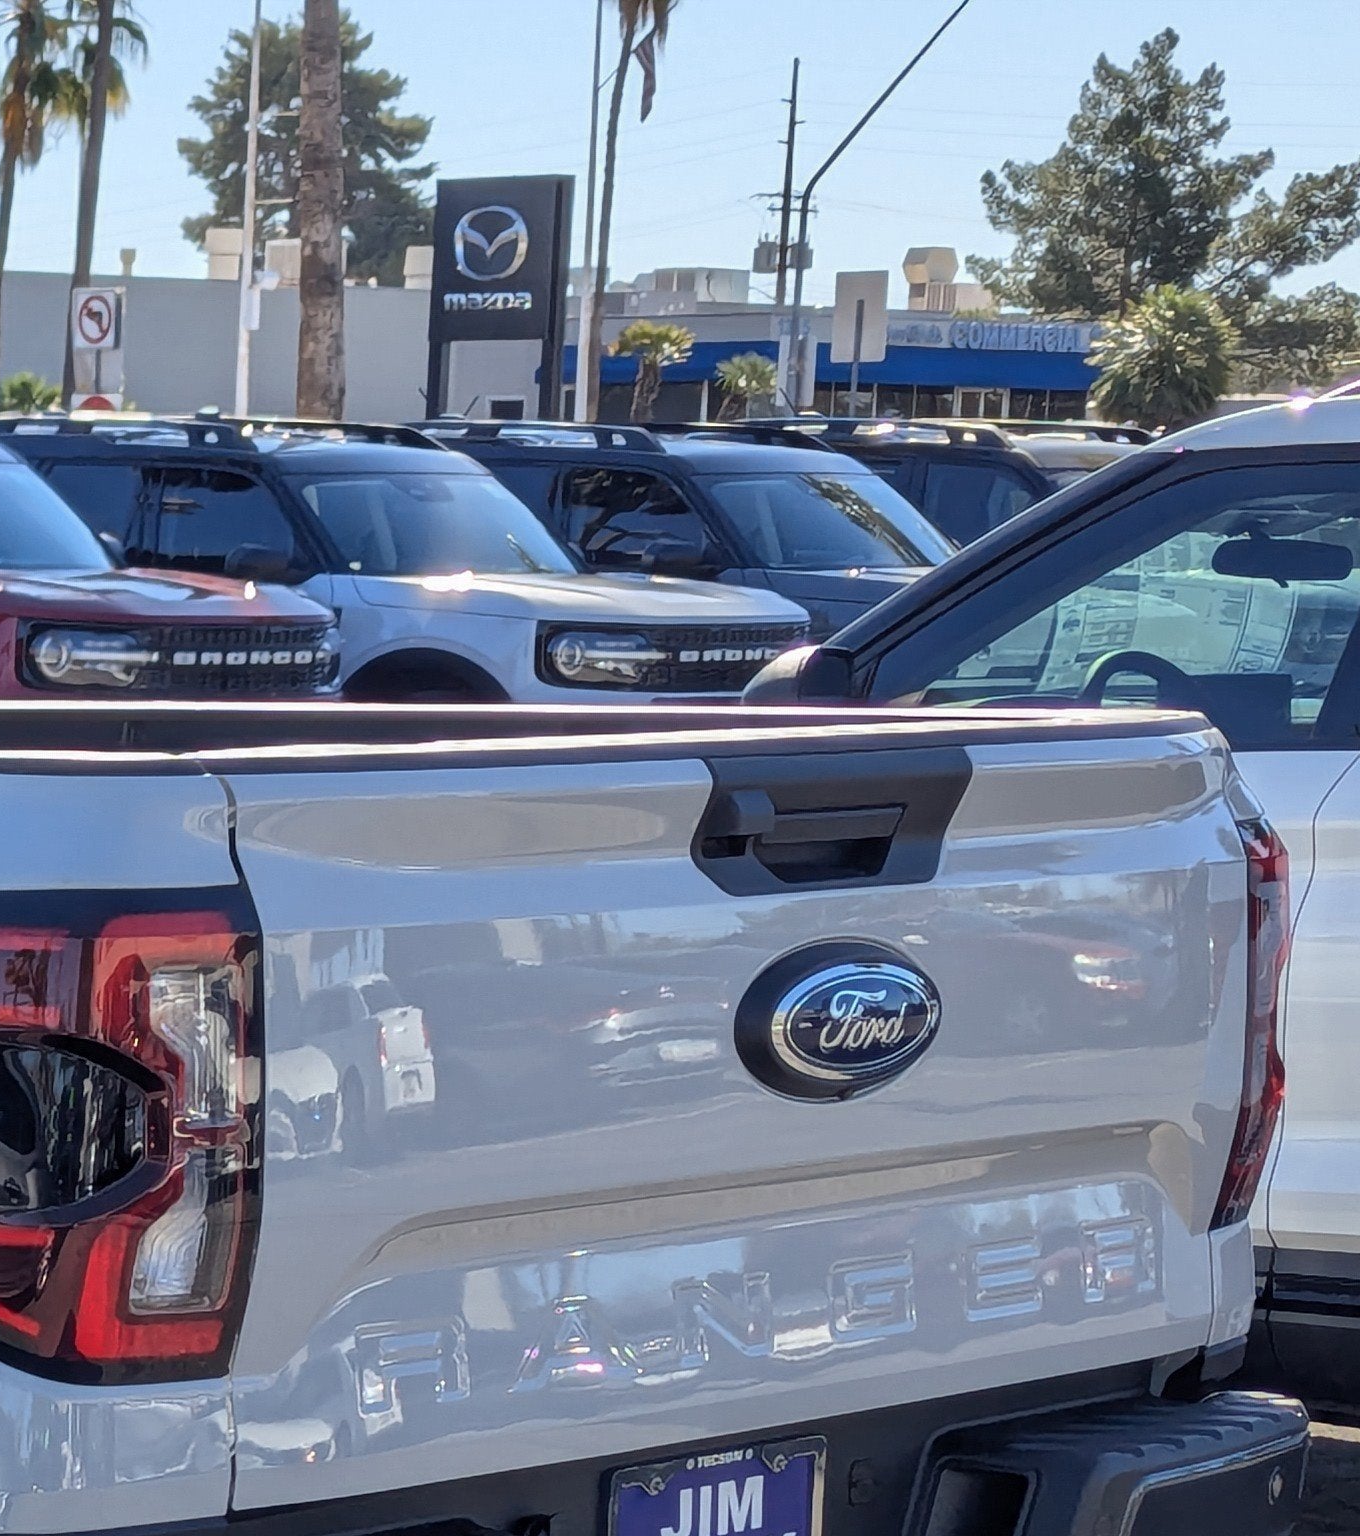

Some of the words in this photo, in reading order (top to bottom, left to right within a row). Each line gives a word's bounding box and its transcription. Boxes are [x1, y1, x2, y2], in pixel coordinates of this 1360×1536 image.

[949, 320, 1089, 353] COMMERCIAL
[172, 651, 313, 666] BRONCO
[819, 989, 908, 1054] Ford
[354, 1212, 1162, 1424] RANGER
